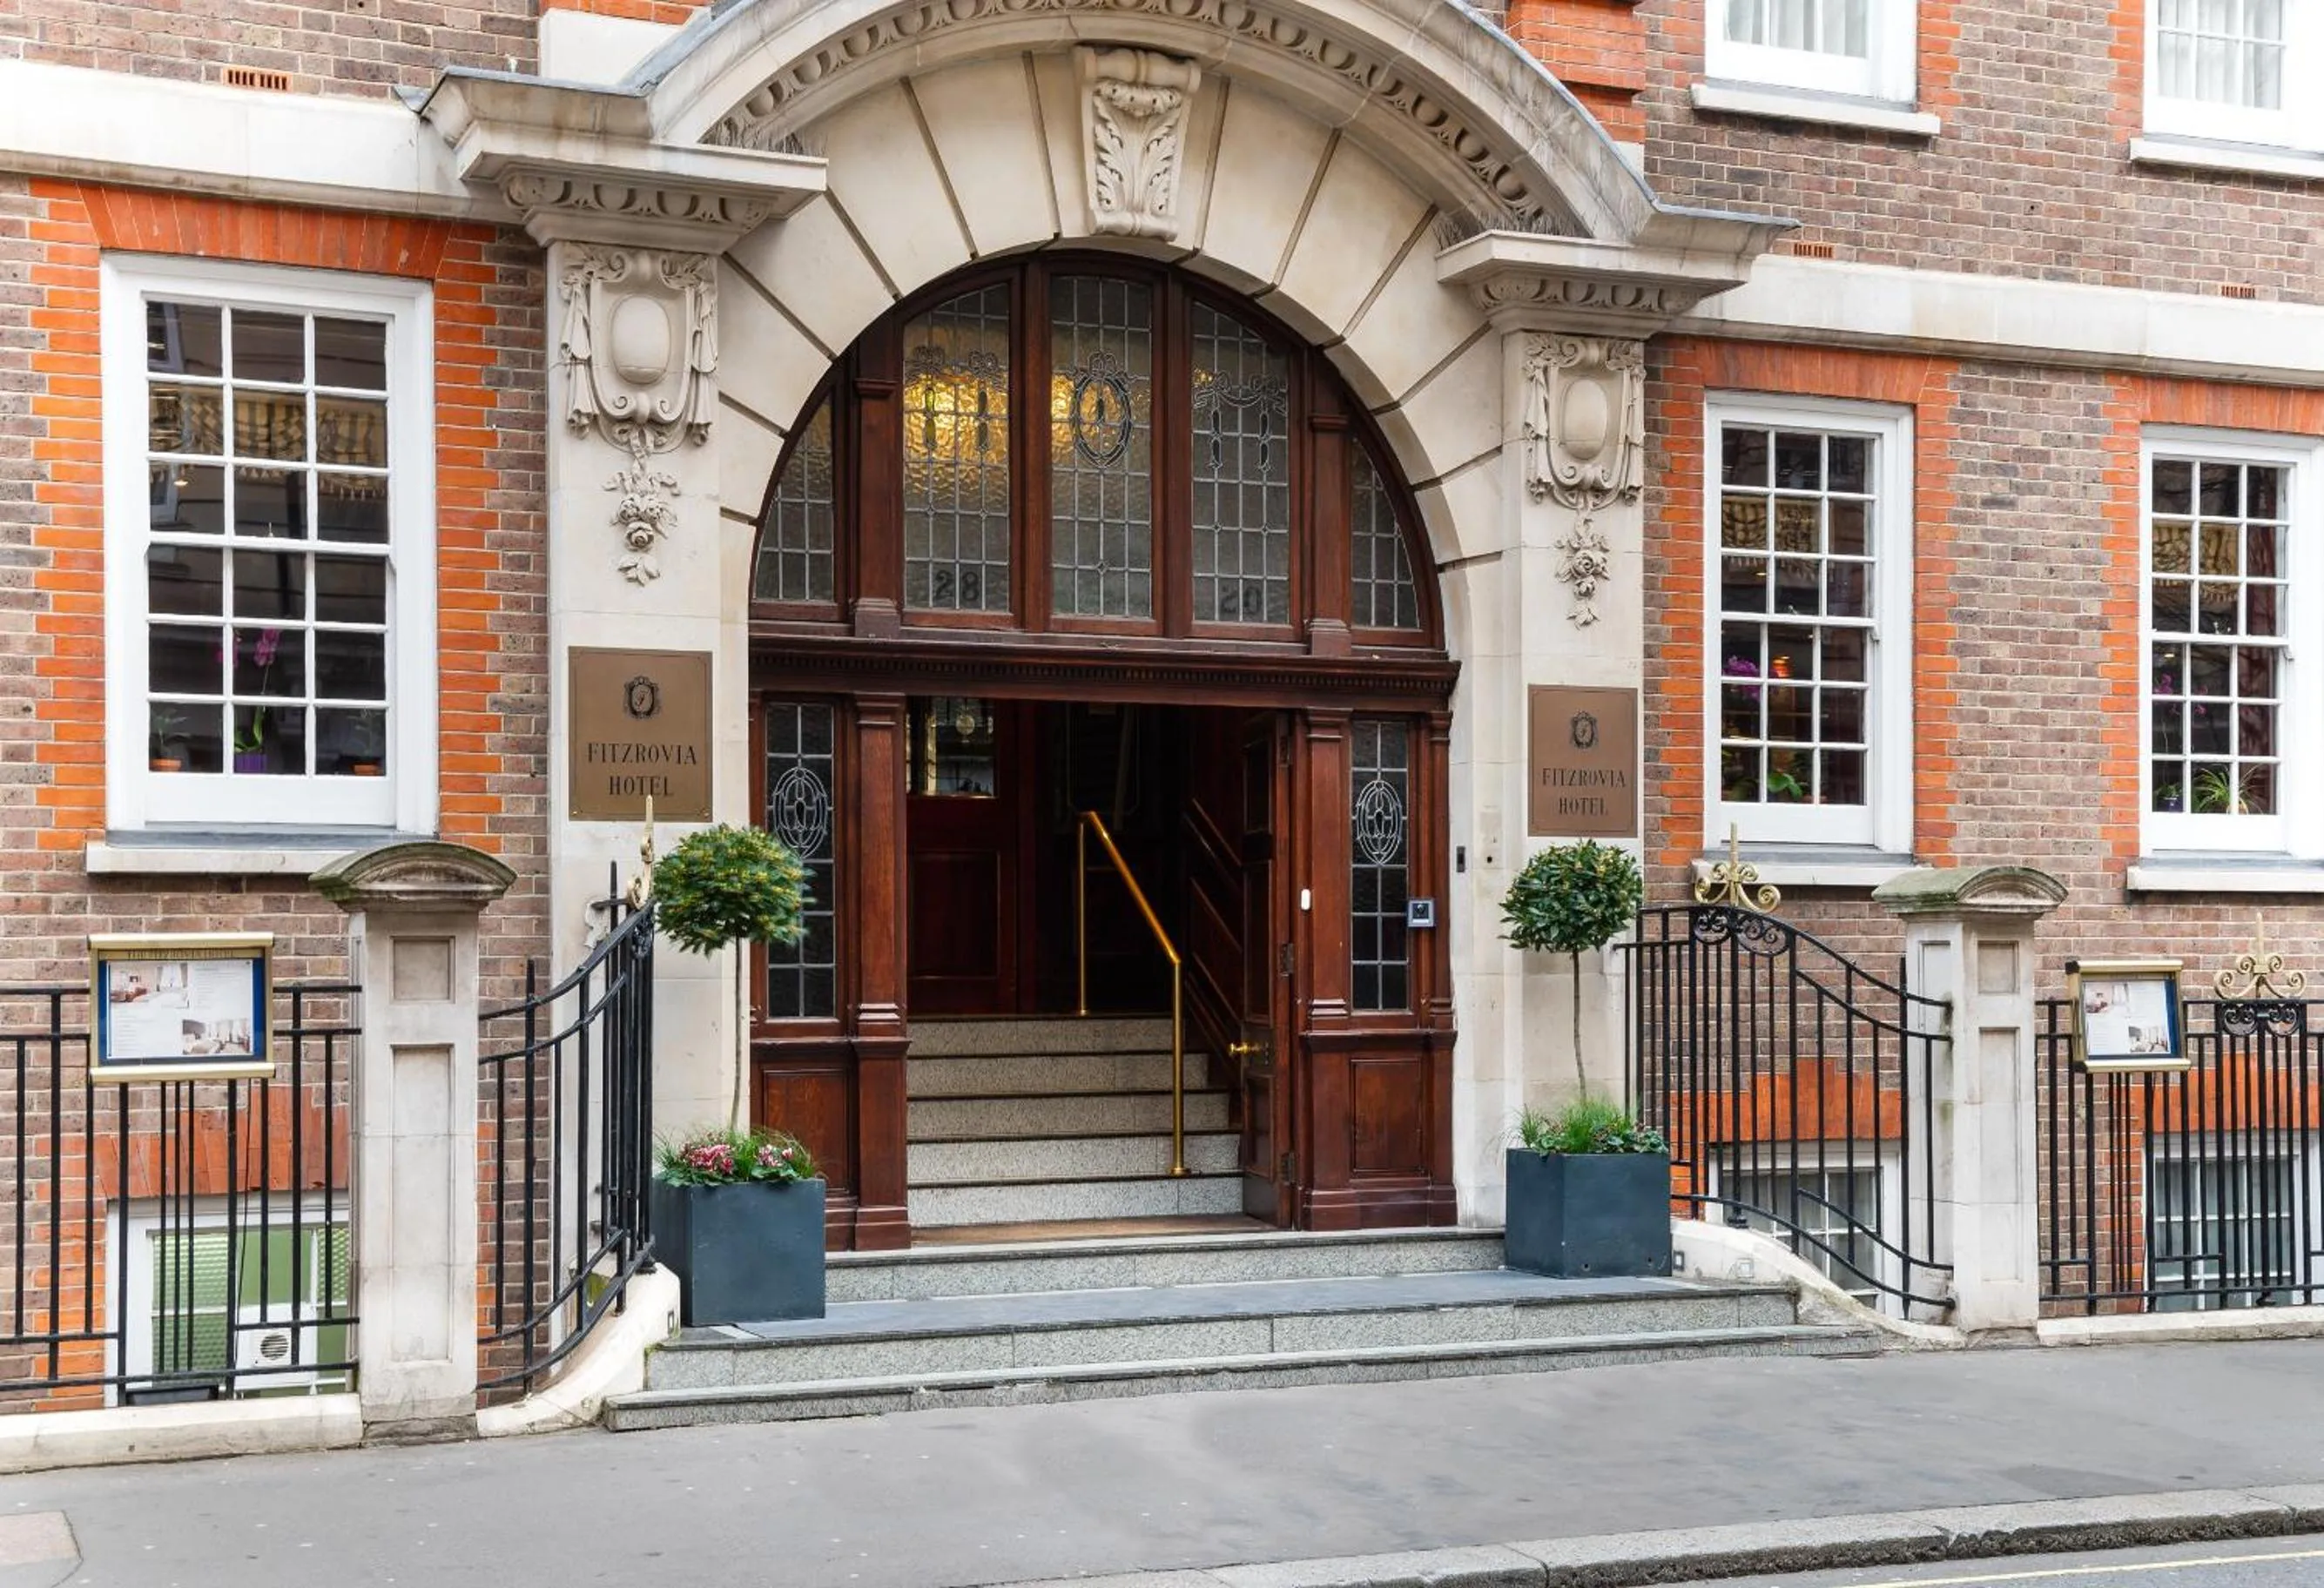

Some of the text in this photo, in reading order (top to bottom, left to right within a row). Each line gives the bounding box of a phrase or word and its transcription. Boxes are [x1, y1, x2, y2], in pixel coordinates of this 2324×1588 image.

[935, 570, 980, 601] 28
[587, 743, 697, 764] FITZROVIA
[610, 775, 674, 797] HOTEL
[1542, 767, 1626, 787] FITZROVIA
[1559, 797, 1608, 816] HOTEL
